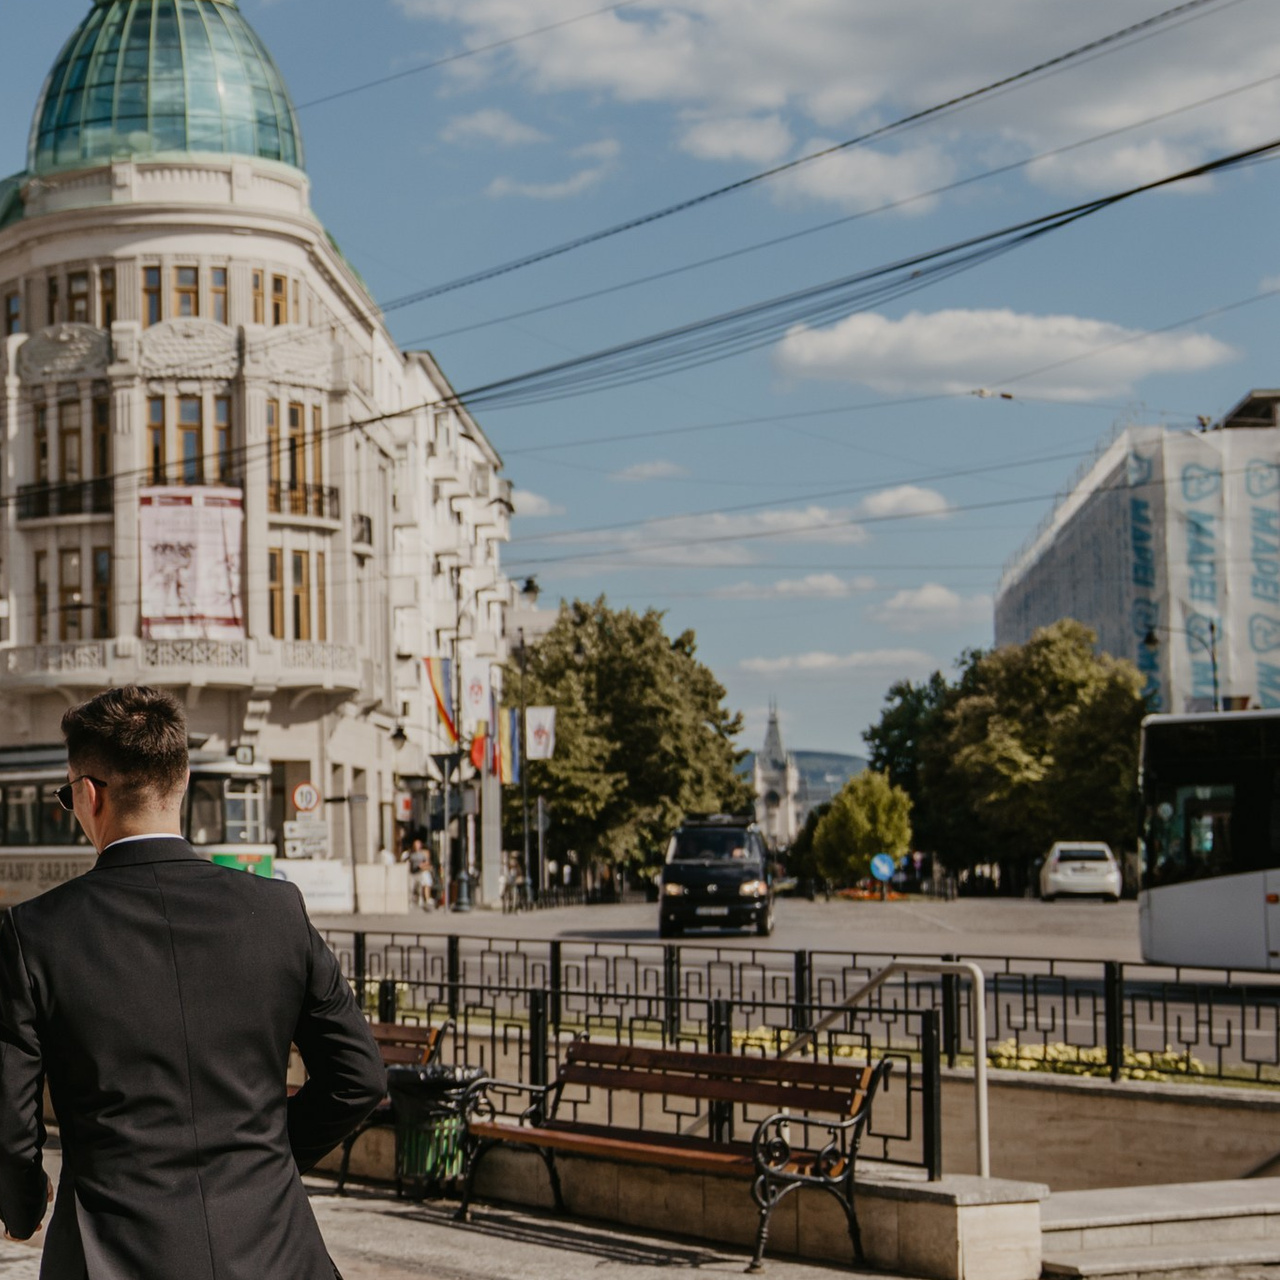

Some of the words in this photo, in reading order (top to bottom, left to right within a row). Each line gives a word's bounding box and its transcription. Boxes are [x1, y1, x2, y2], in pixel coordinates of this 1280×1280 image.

[1131, 498, 1155, 589] MAPEI
[1187, 509, 1217, 603] MAPEI
[1250, 505, 1280, 604] MAPEI
